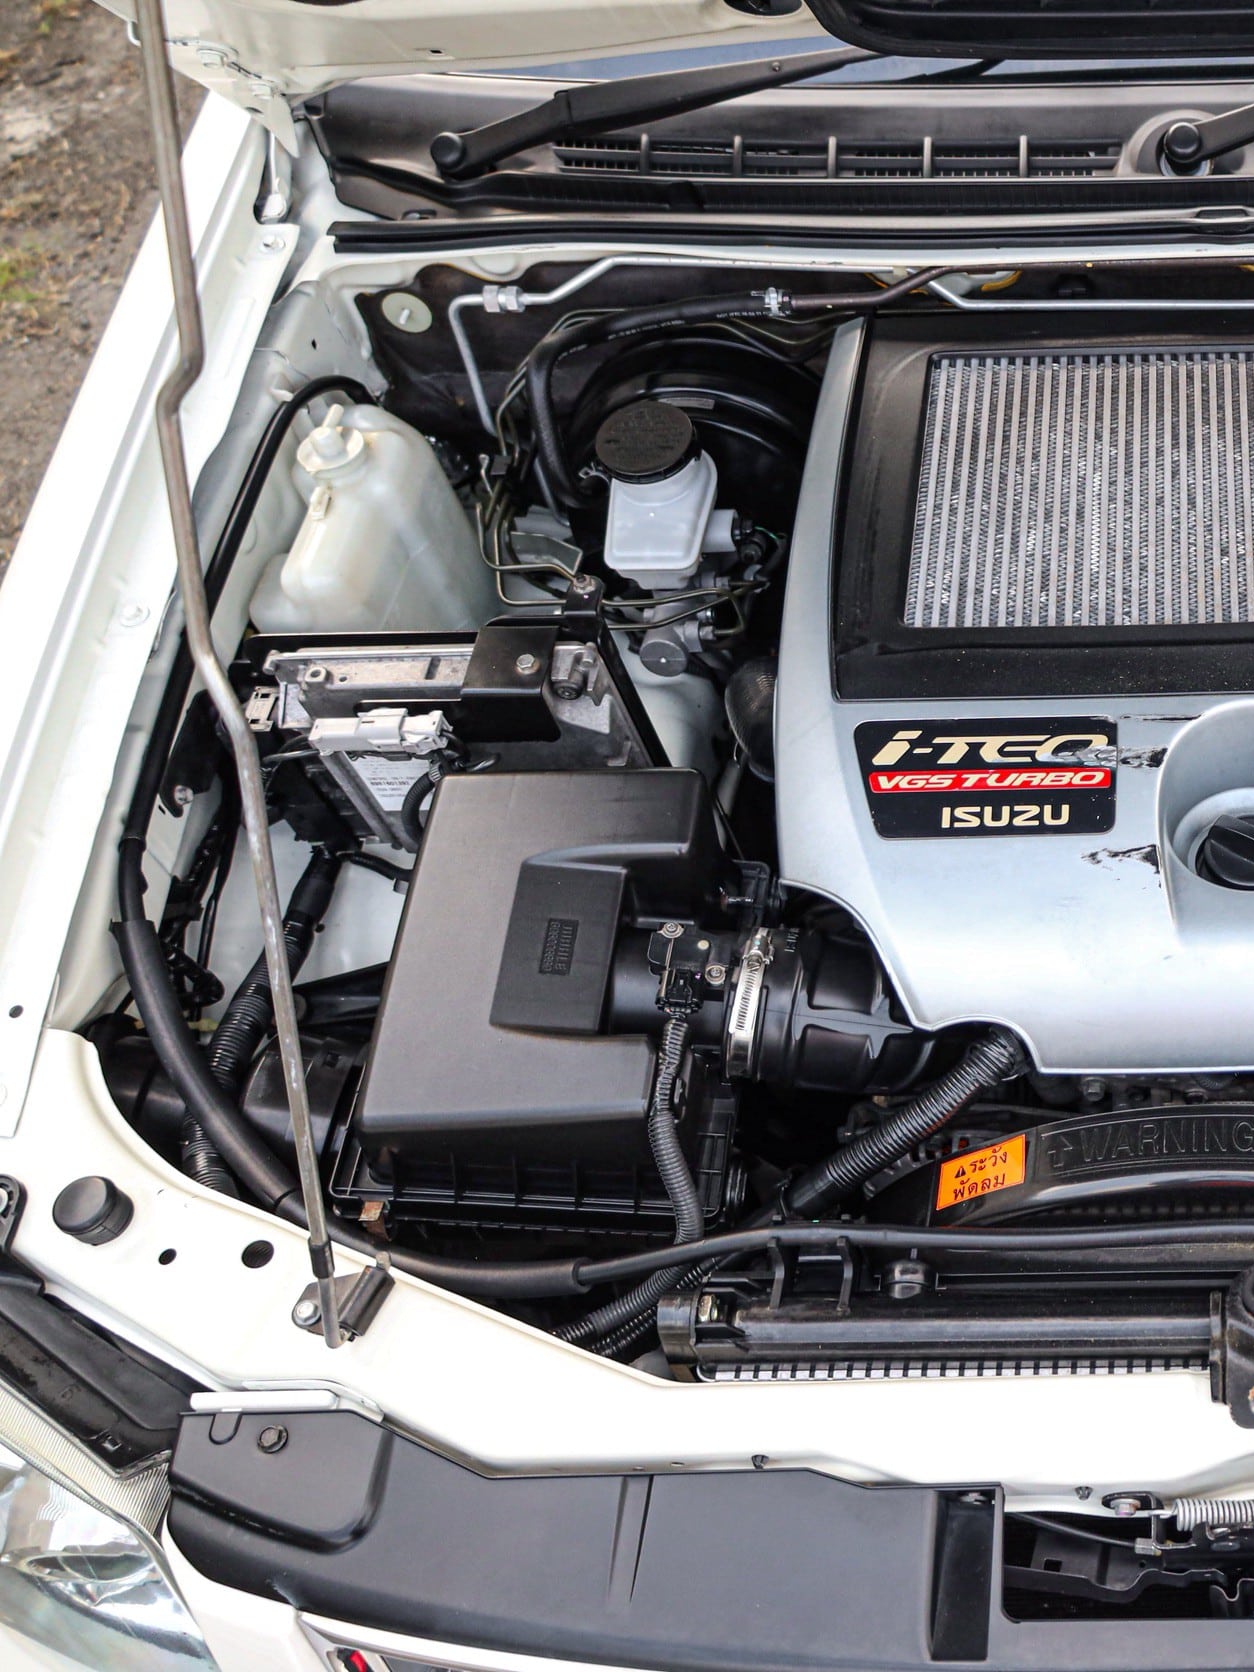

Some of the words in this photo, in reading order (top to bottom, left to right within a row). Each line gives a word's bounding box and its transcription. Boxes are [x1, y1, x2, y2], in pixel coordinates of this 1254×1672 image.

[878, 772, 953, 789] VGS
[957, 771, 1105, 788] TURBO
[941, 804, 1070, 828] ISUZU
[969, 1146, 1008, 1173] ระวัง
[953, 1173, 1006, 1200] พัดลม
